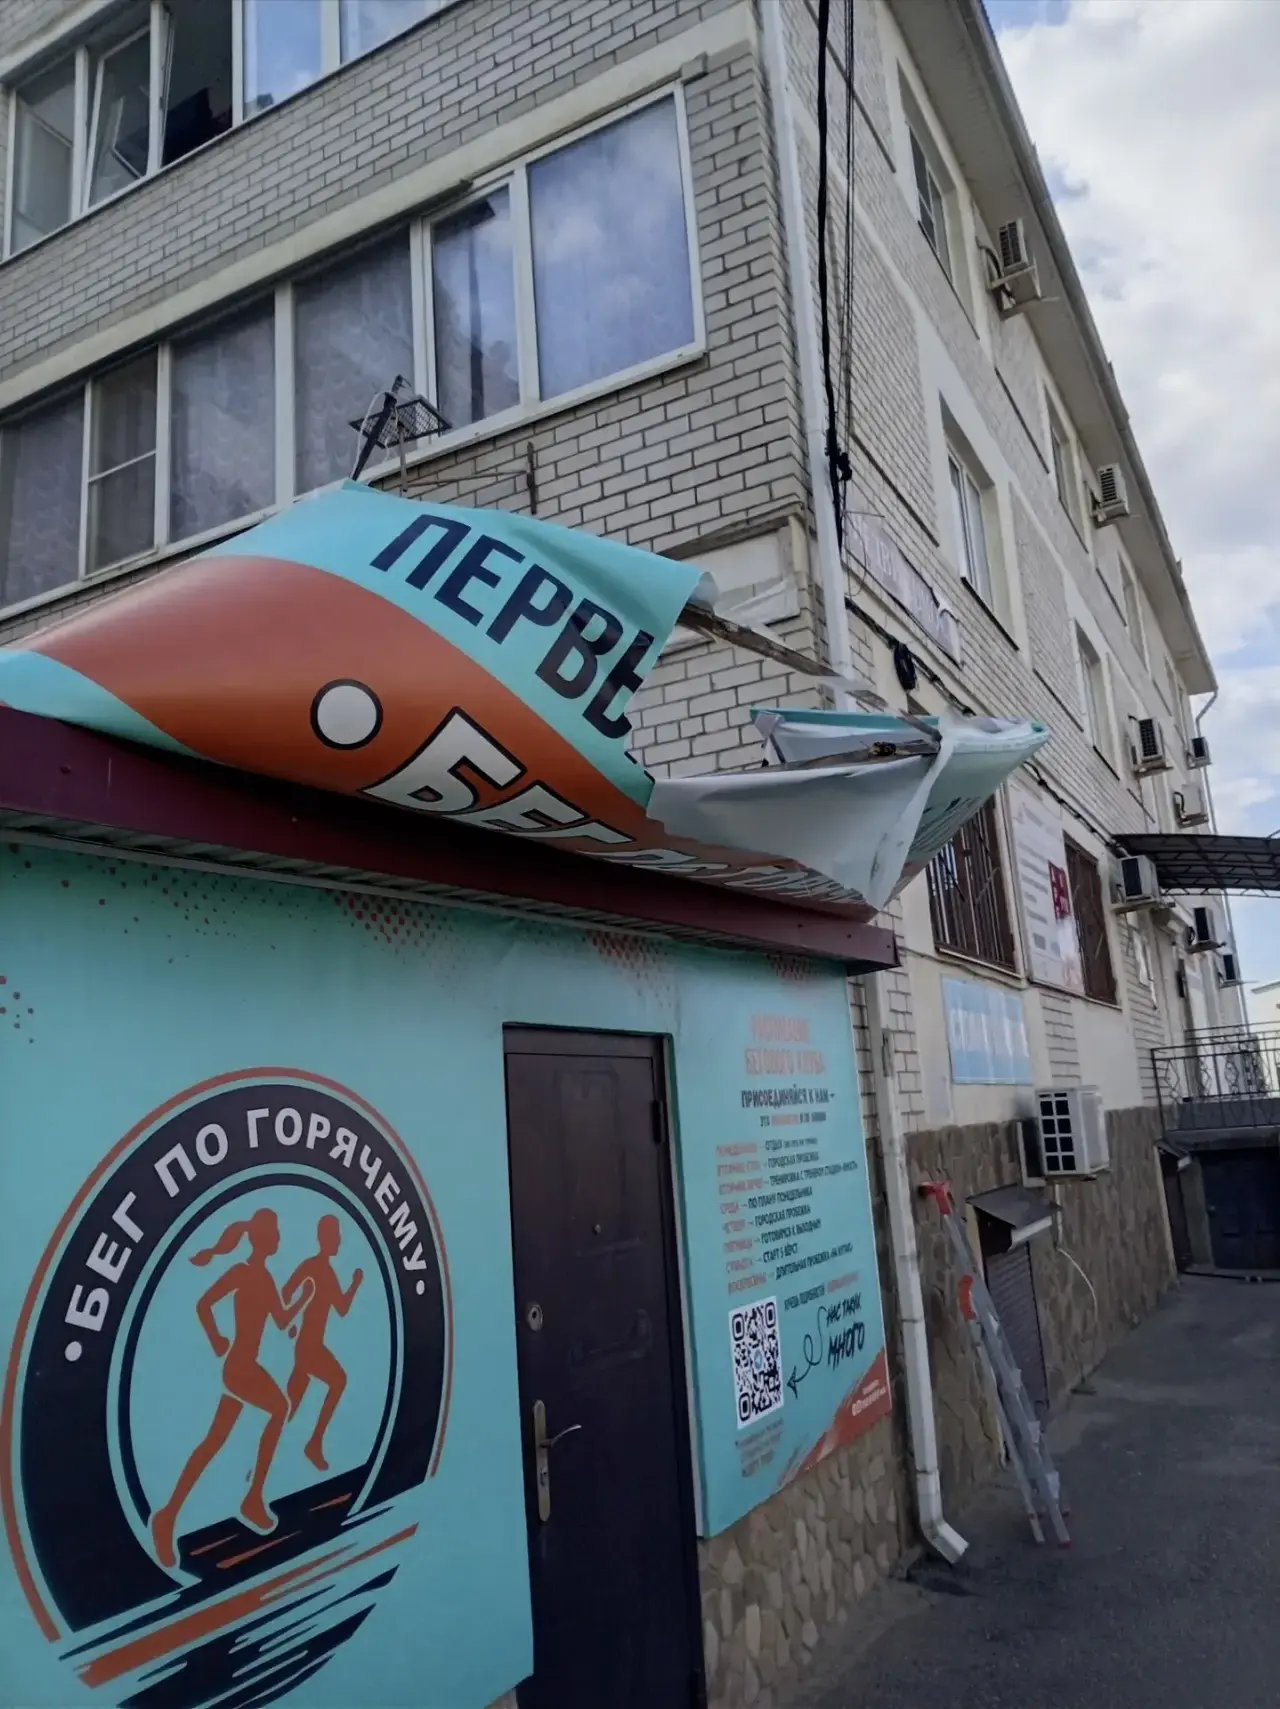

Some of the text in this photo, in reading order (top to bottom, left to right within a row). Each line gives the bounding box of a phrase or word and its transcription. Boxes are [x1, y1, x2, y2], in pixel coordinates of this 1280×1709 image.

[741, 1084, 808, 1109] ПРИСОЕДИНЯЙСЯ
[748, 1197, 757, 1209] ПО
[755, 1210, 785, 1227] ГОРОДСКАЯ
[785, 1204, 811, 1219] ПРОБЕЖКА
[65, 1107, 427, 1332] БЕГ ПО ГОРЯЧЕМУ
[763, 1248, 780, 1263] СТАРТ
[826, 1300, 841, 1328] НАС
[828, 1322, 865, 1371] МНОГО
